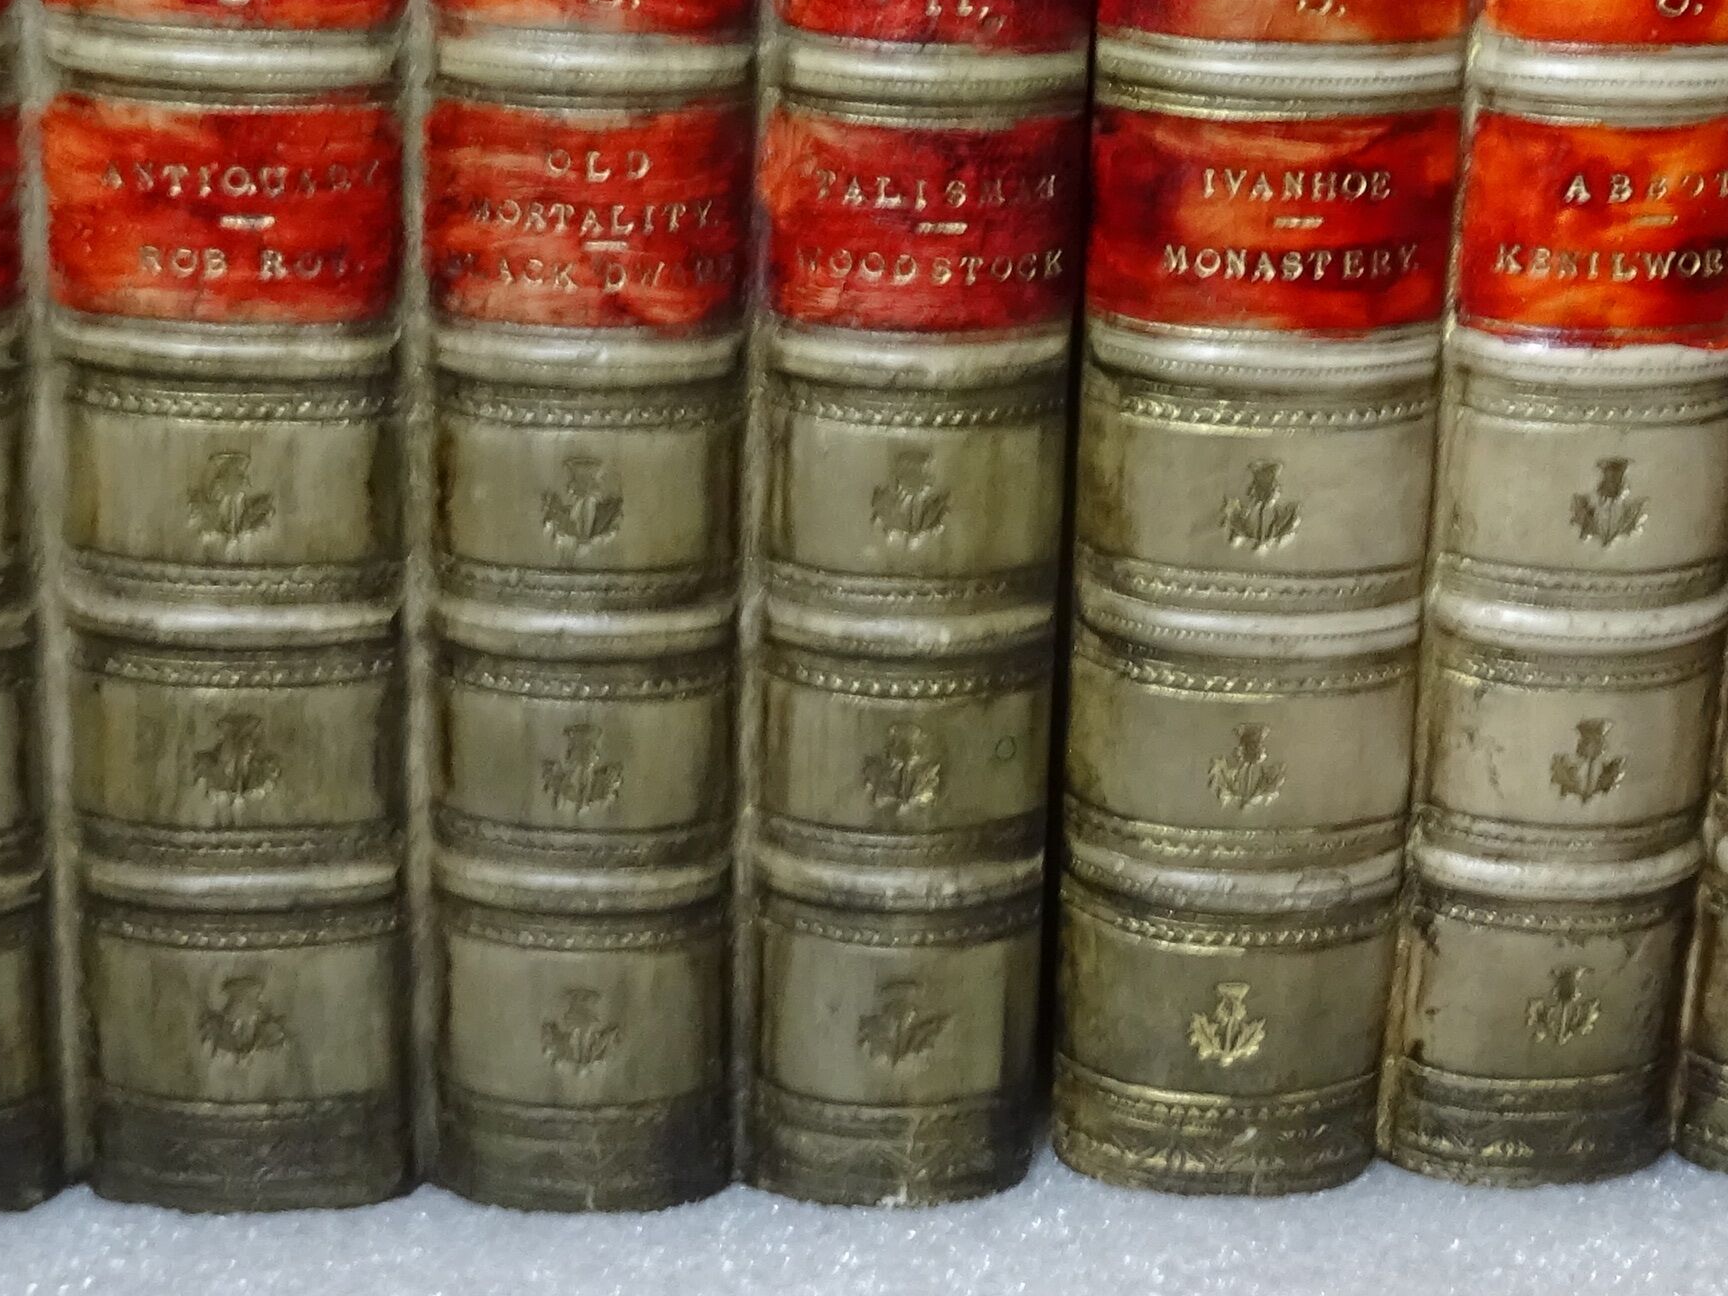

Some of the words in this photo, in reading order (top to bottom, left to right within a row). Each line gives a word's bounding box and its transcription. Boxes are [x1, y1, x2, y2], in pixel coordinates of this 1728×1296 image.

[101, 160, 379, 198] ANTIQUARY
[546, 149, 651, 183] OLD
[1202, 167, 1392, 201] IVANHOE
[138, 245, 228, 280] ROB
